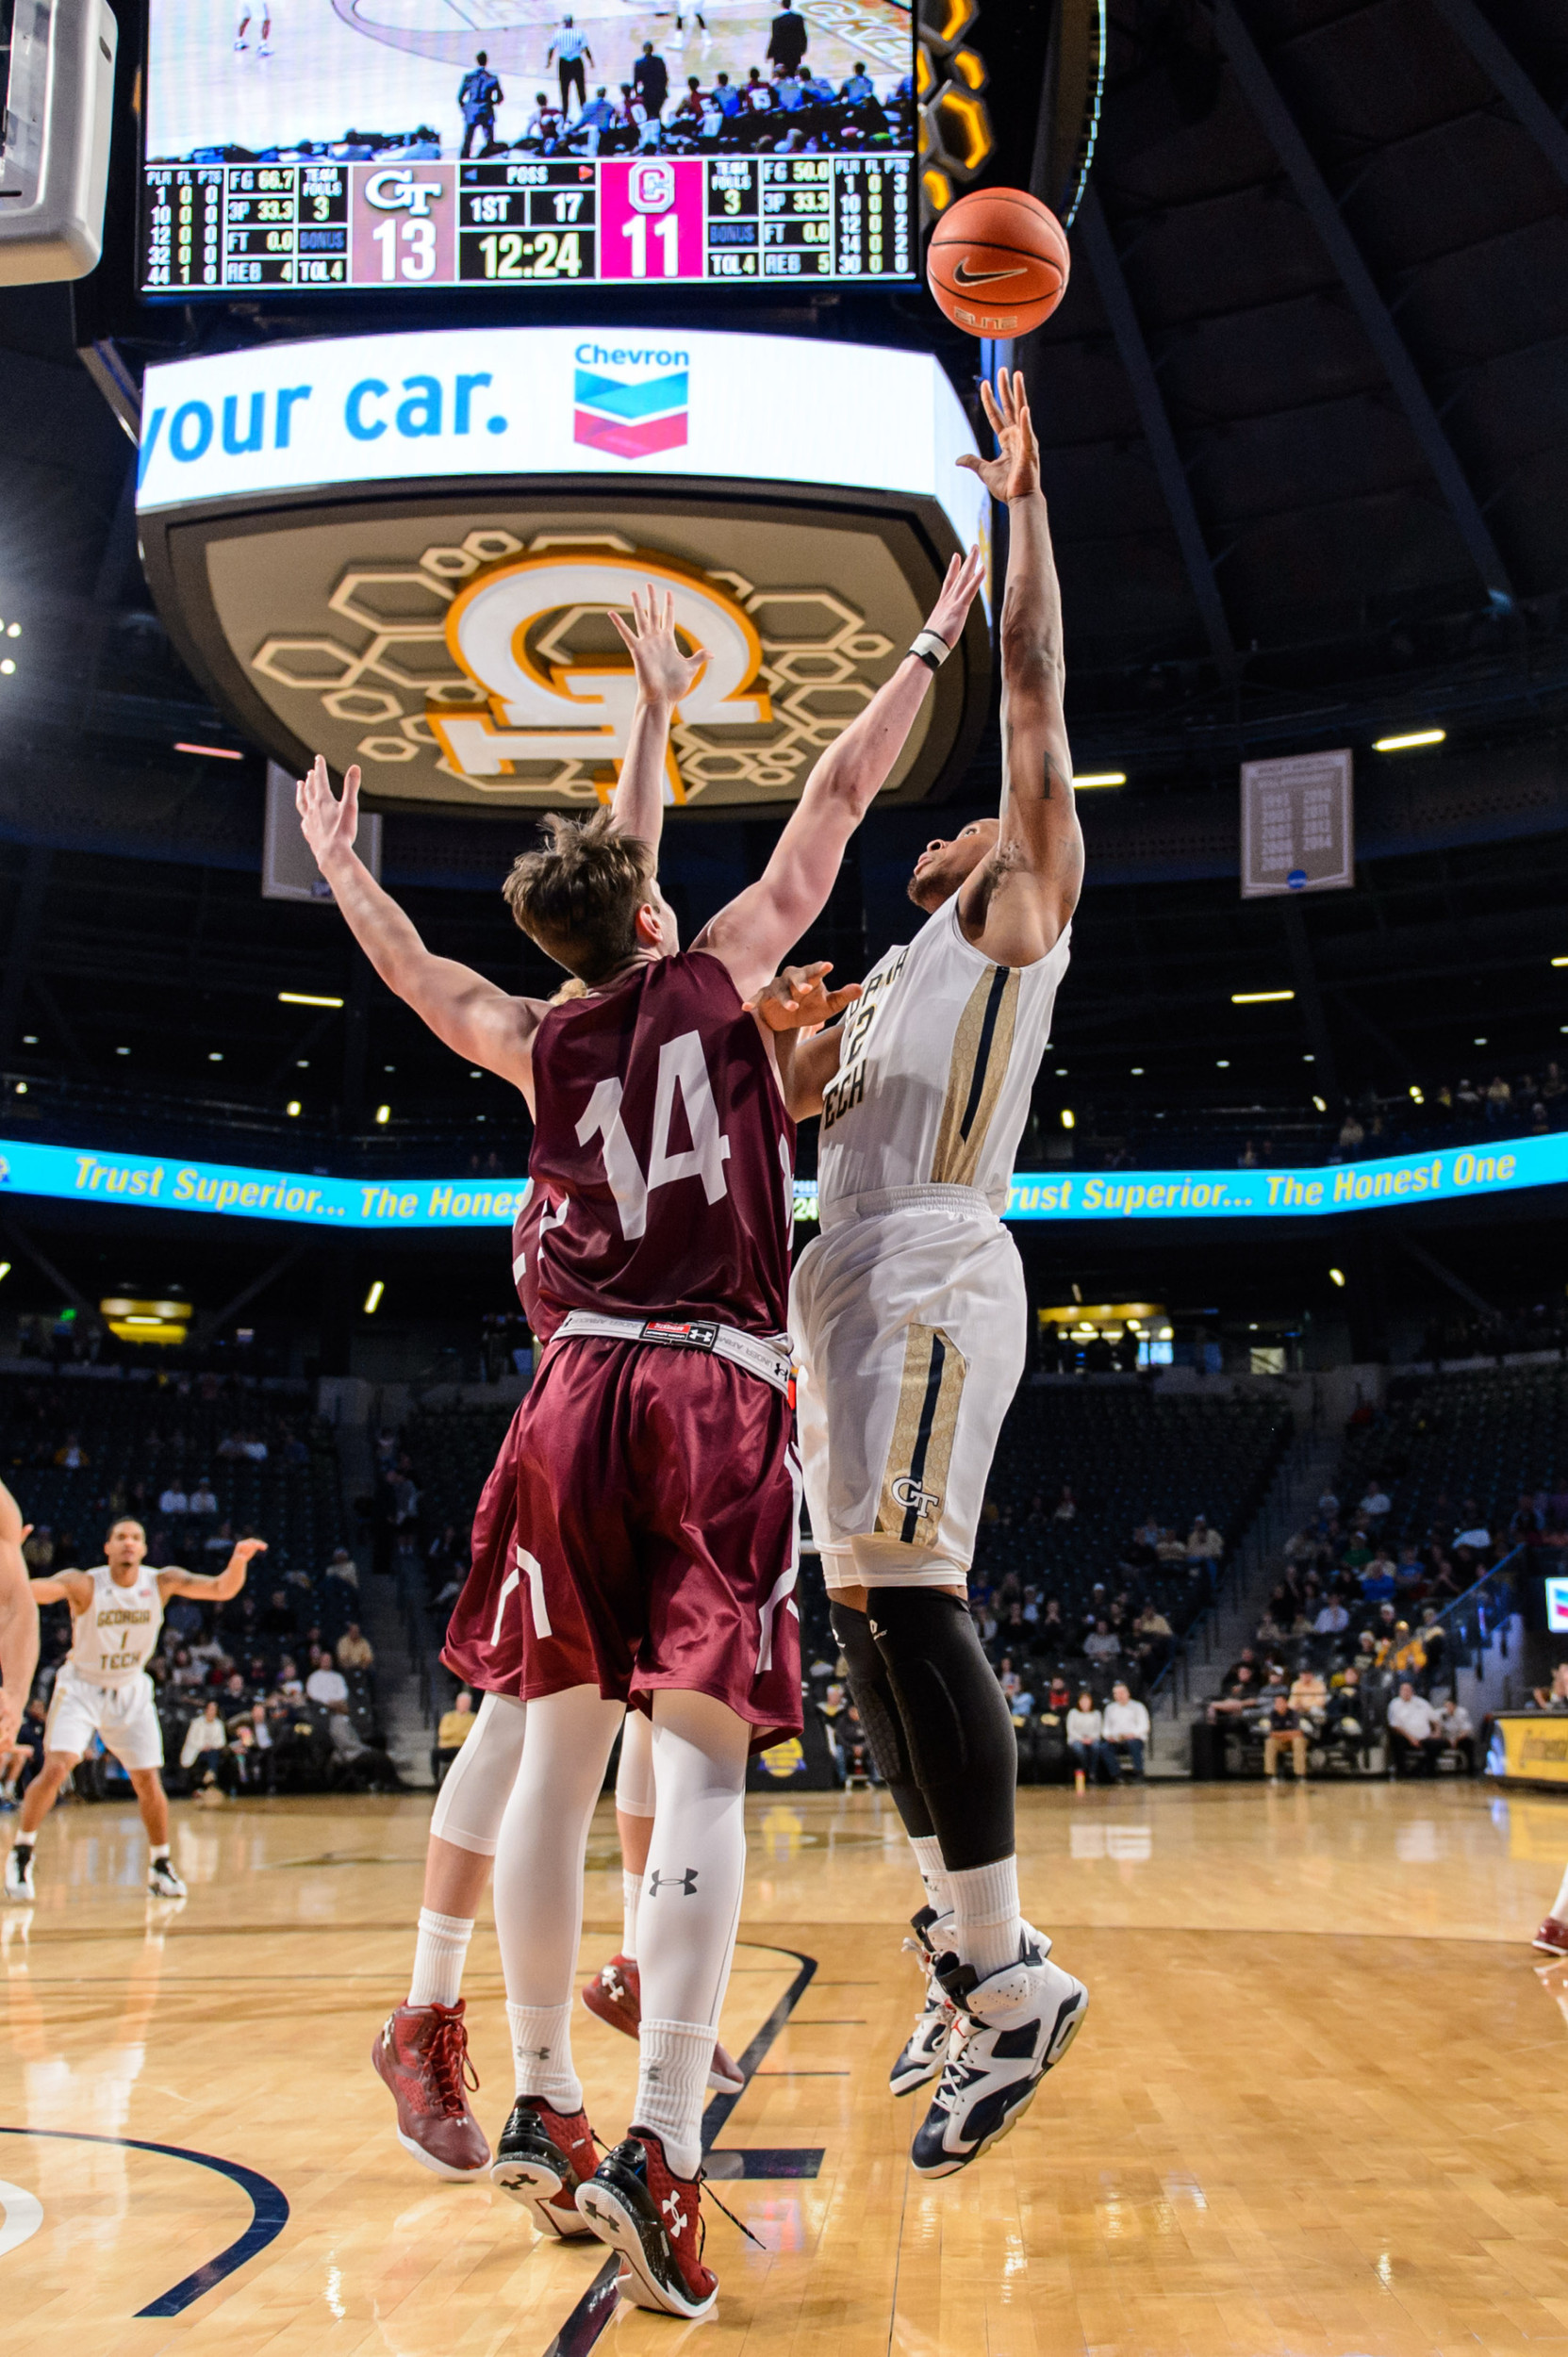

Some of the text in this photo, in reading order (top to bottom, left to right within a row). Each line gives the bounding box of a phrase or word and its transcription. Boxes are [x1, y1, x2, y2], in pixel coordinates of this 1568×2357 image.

[230, 170, 293, 190] FG 66.7
[506, 166, 549, 185] POSS
[765, 160, 829, 182] FG 50.0
[365, 170, 441, 216] GT
[845, 173, 907, 194] 1 0 3
[156, 185, 218, 205] 1 0 0
[724, 189, 741, 215] 3
[765, 191, 829, 212] 3P 33.3
[840, 193, 907, 214] 10 0 0
[151, 205, 218, 225] 10 0 0
[228, 200, 293, 221] 3P 33.3
[313, 196, 329, 222] 3
[470, 194, 511, 222] 1ST
[553, 192, 584, 222] 17
[710, 225, 754, 243] BONUS
[765, 223, 830, 243] FT 0.0
[840, 213, 908, 234] 12 0 2
[151, 224, 218, 245] 12 0 0
[228, 231, 293, 252] FT 0.0
[300, 231, 344, 249] BONUS
[840, 234, 908, 254] 14 0 2
[148, 244, 217, 265] 32 0 0
[373, 219, 436, 281] 13
[479, 232, 582, 278] 12:24
[622, 215, 678, 277] 11
[228, 261, 292, 283] REB 4
[299, 261, 343, 281] TOL 4
[711, 255, 755, 275] TOL 4
[766, 253, 830, 273] REB 5
[839, 254, 908, 274] 30 0 0
[148, 264, 217, 285] 44 1 0
[575, 343, 688, 366] Chevron
[344, 372, 508, 441] car.
[824, 1058, 867, 1129] ECH
[574, 1030, 732, 1241] 14
[75, 1157, 164, 1196] Trust
[173, 1168, 345, 1216] Superior...
[361, 1187, 419, 1218] The
[1007, 1153, 1515, 1215] rust Superior... The Honest One
[892, 1477, 939, 1518] GT
[97, 1609, 151, 1627] GEORGIA
[121, 1630, 128, 1650] 1
[100, 1651, 141, 1671] TECH
